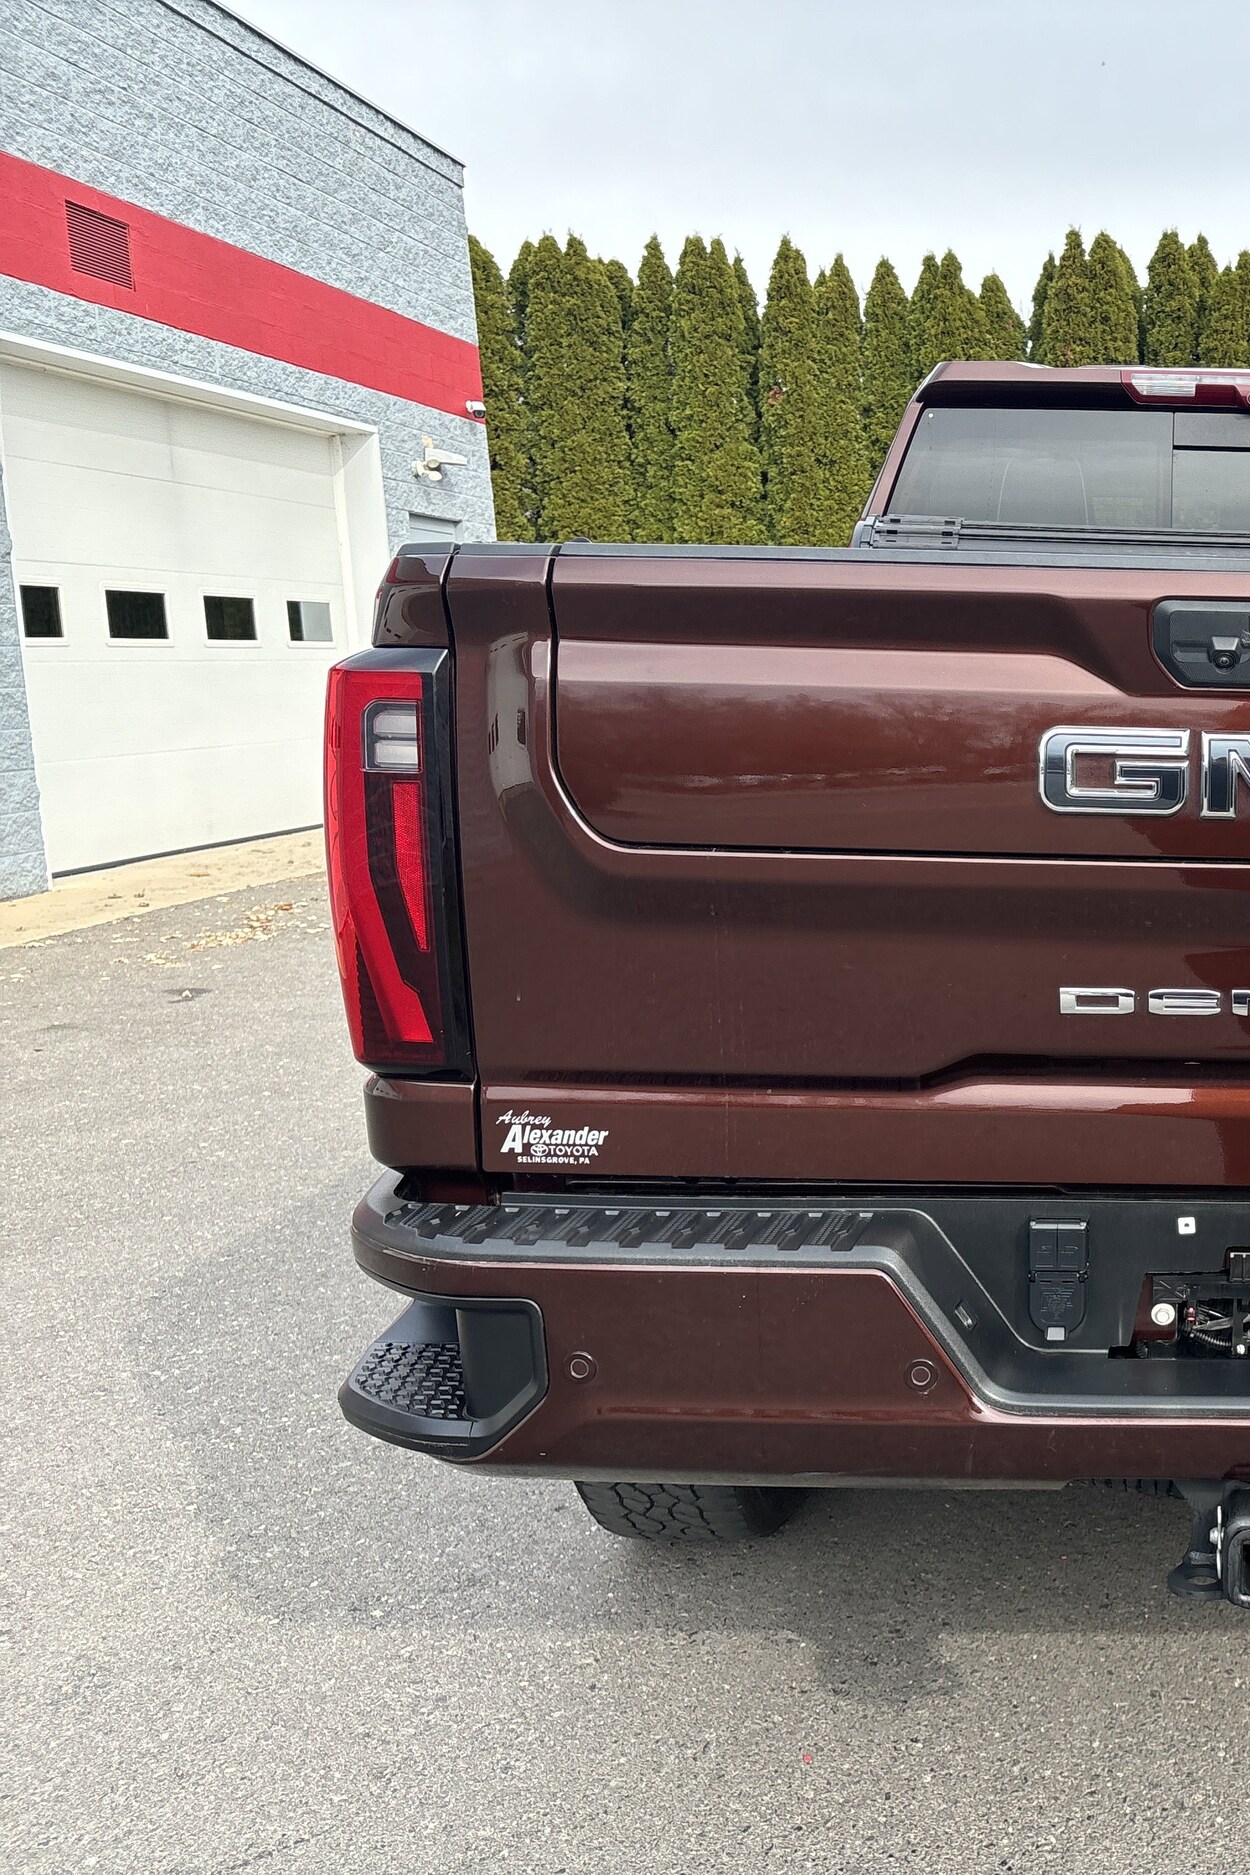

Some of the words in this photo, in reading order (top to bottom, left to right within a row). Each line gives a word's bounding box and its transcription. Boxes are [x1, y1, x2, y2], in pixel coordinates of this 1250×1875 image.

[495, 1109, 552, 1129] Aubrey
[499, 1124, 609, 1154] Alexander
[548, 1145, 599, 1157] TOYOTA
[517, 1155, 577, 1166] SELINSGROVE,
[578, 1157, 590, 1165] PA
